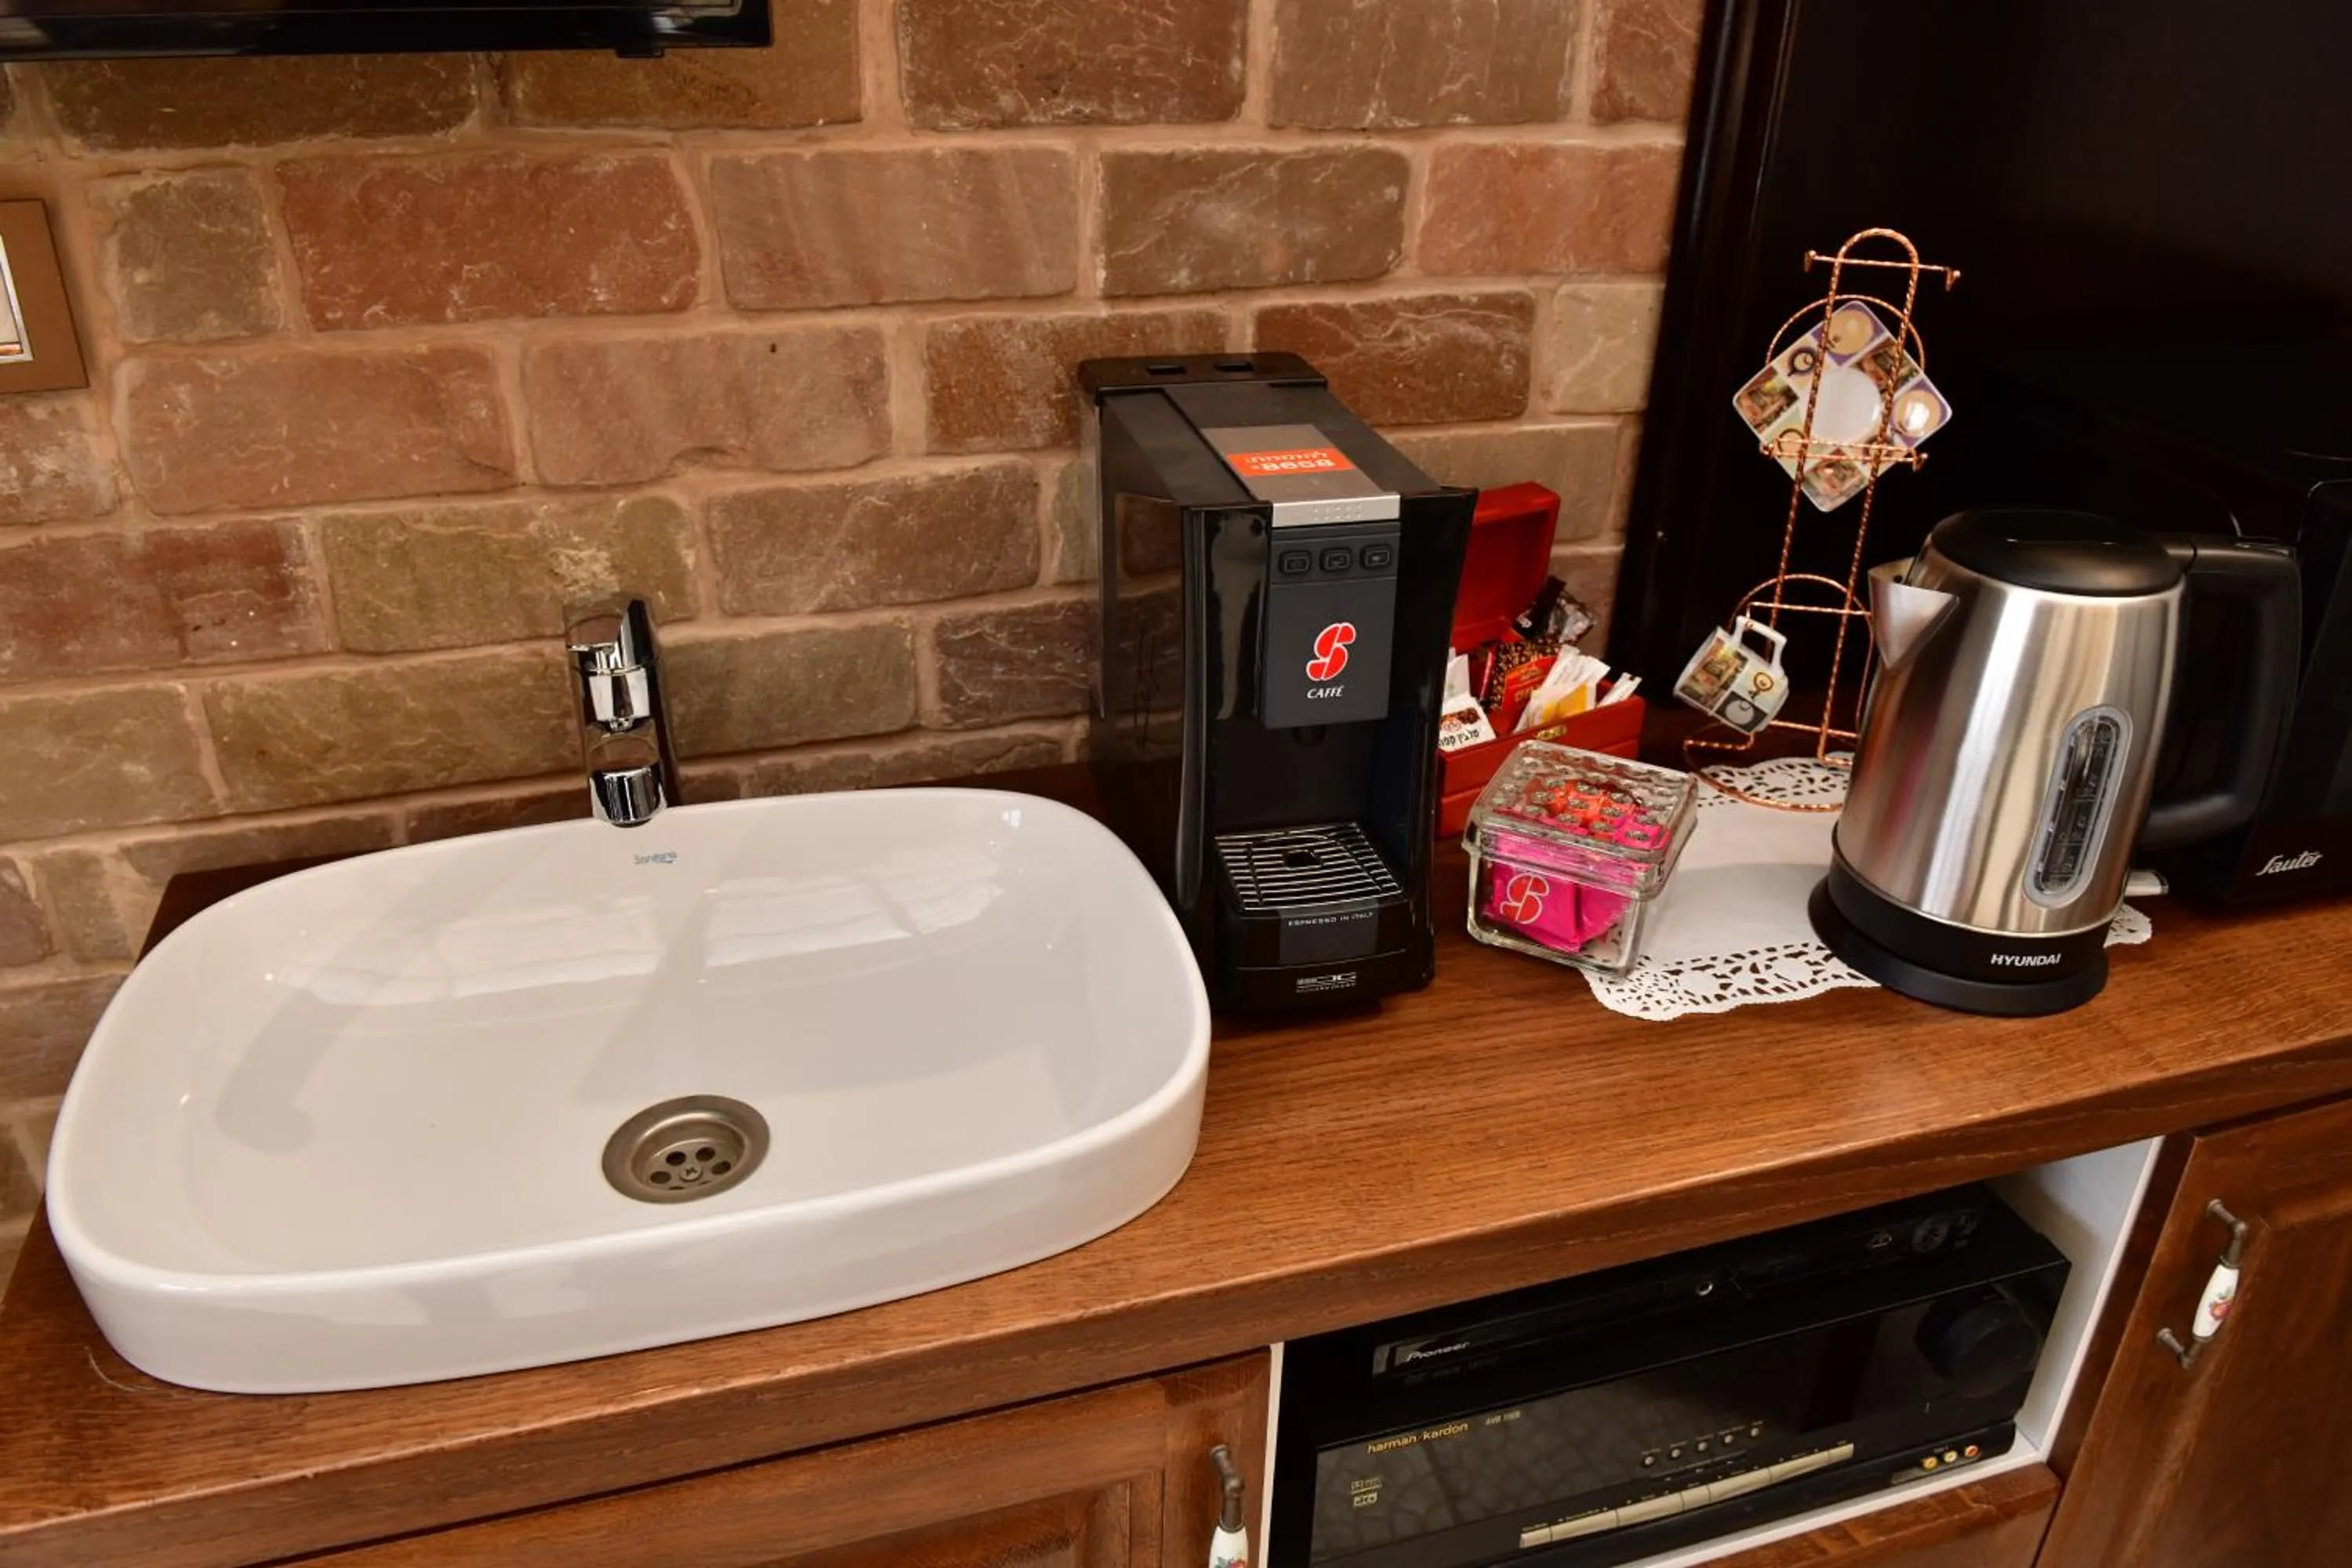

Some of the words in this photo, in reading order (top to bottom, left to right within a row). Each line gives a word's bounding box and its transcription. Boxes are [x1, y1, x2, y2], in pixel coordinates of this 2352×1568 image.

[1991, 953, 2062, 967] HYUNDAI
[1406, 1341, 1471, 1362] Pioneer
[1422, 1421, 1468, 1441] kardon
